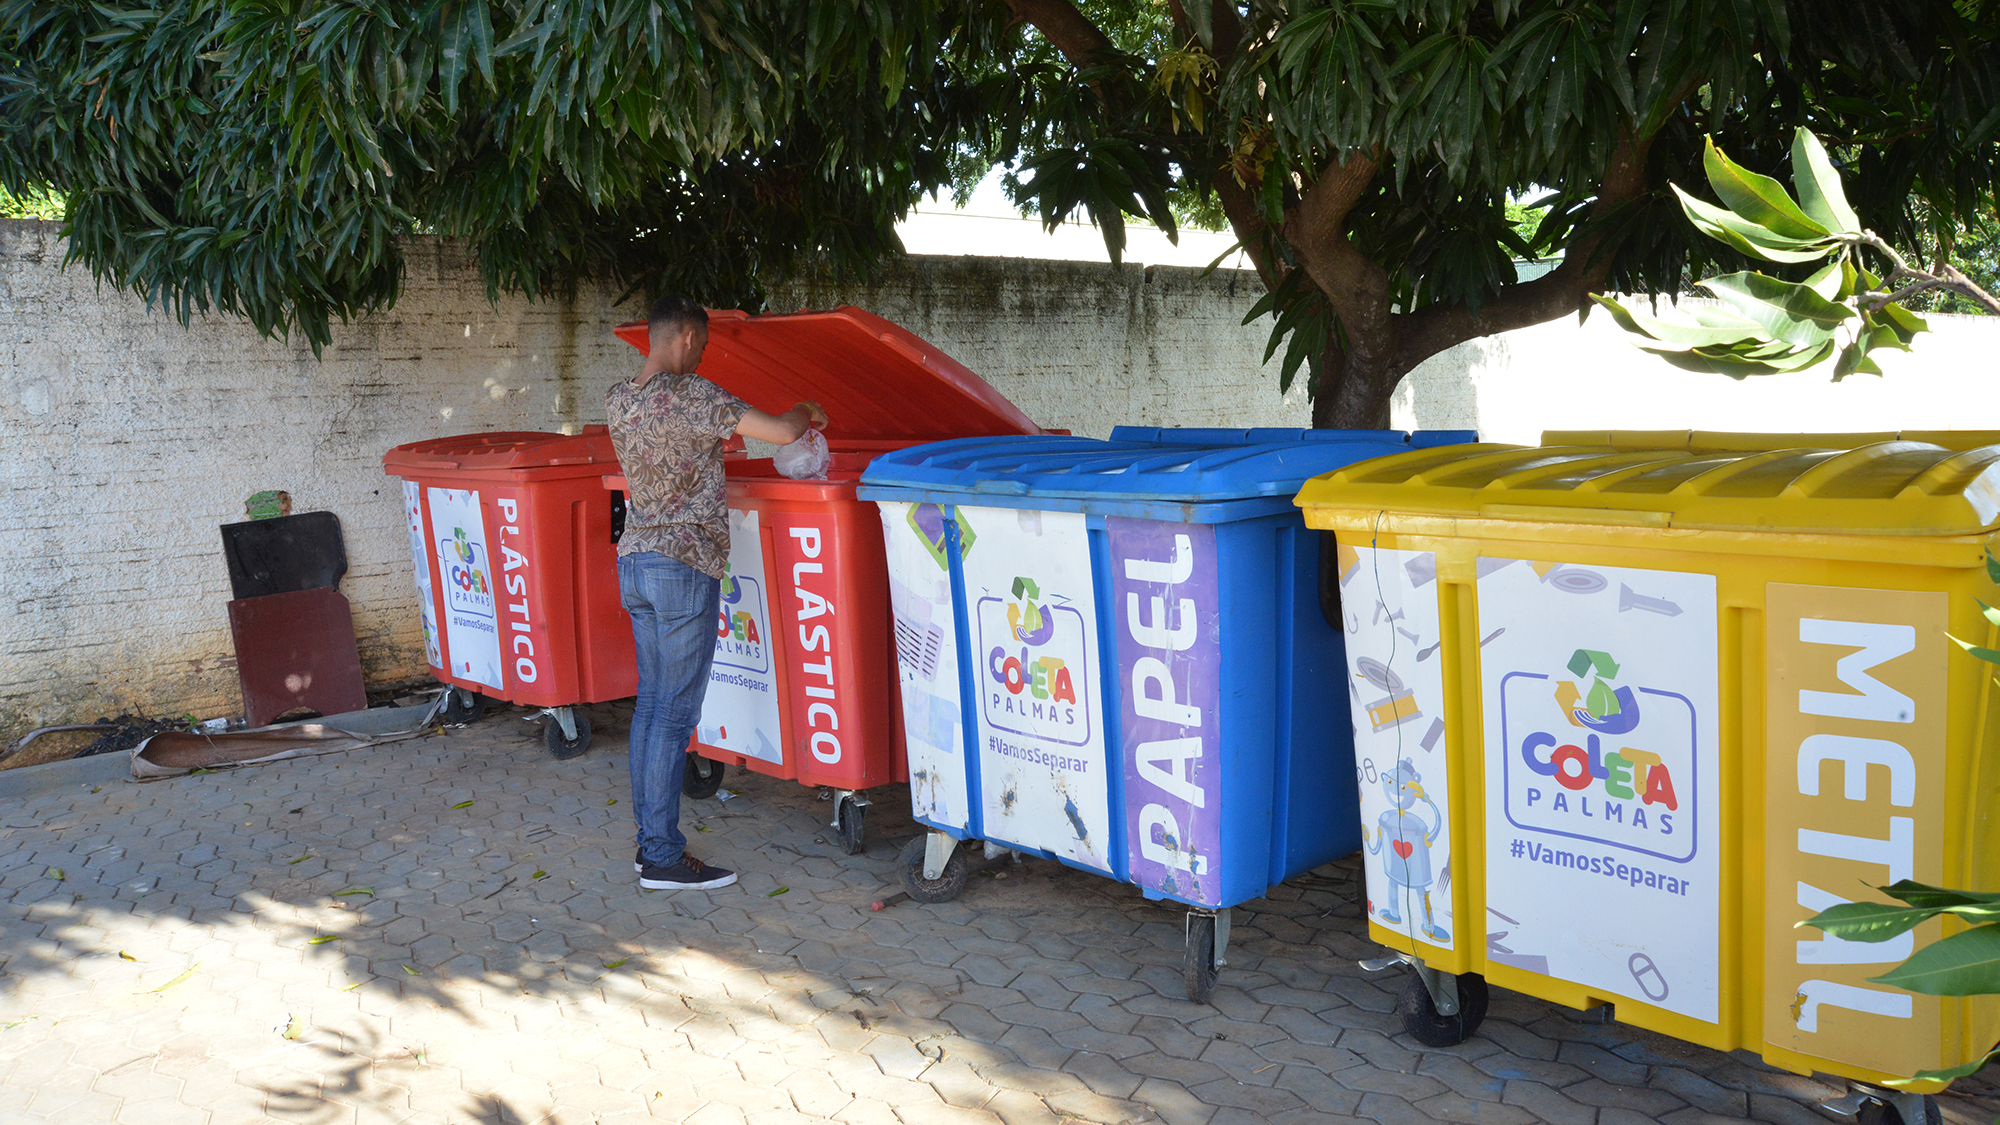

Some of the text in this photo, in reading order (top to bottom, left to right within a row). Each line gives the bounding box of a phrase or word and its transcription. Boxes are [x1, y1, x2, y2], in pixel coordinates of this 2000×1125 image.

[451, 565, 489, 596] COLETA
[455, 591, 490, 607] PALMAS
[497, 498, 538, 683] PLÁSTICO
[453, 616, 495, 634] #VamosSeparar
[718, 604, 760, 645] OLETA
[789, 527, 842, 765] PLÁSTICO
[716, 640, 760, 659] ALMAS
[988, 646, 1077, 705] COLETA
[992, 693, 1075, 726] PALMAS
[1124, 534, 1208, 875] PAPEL
[988, 735, 1089, 774] #VamosSeparar
[1521, 731, 1679, 812] COLETA
[1526, 787, 1674, 835] PALMAS
[1795, 617, 1916, 1034] METAL
[1510, 838, 1690, 897] #VamosSeparar
